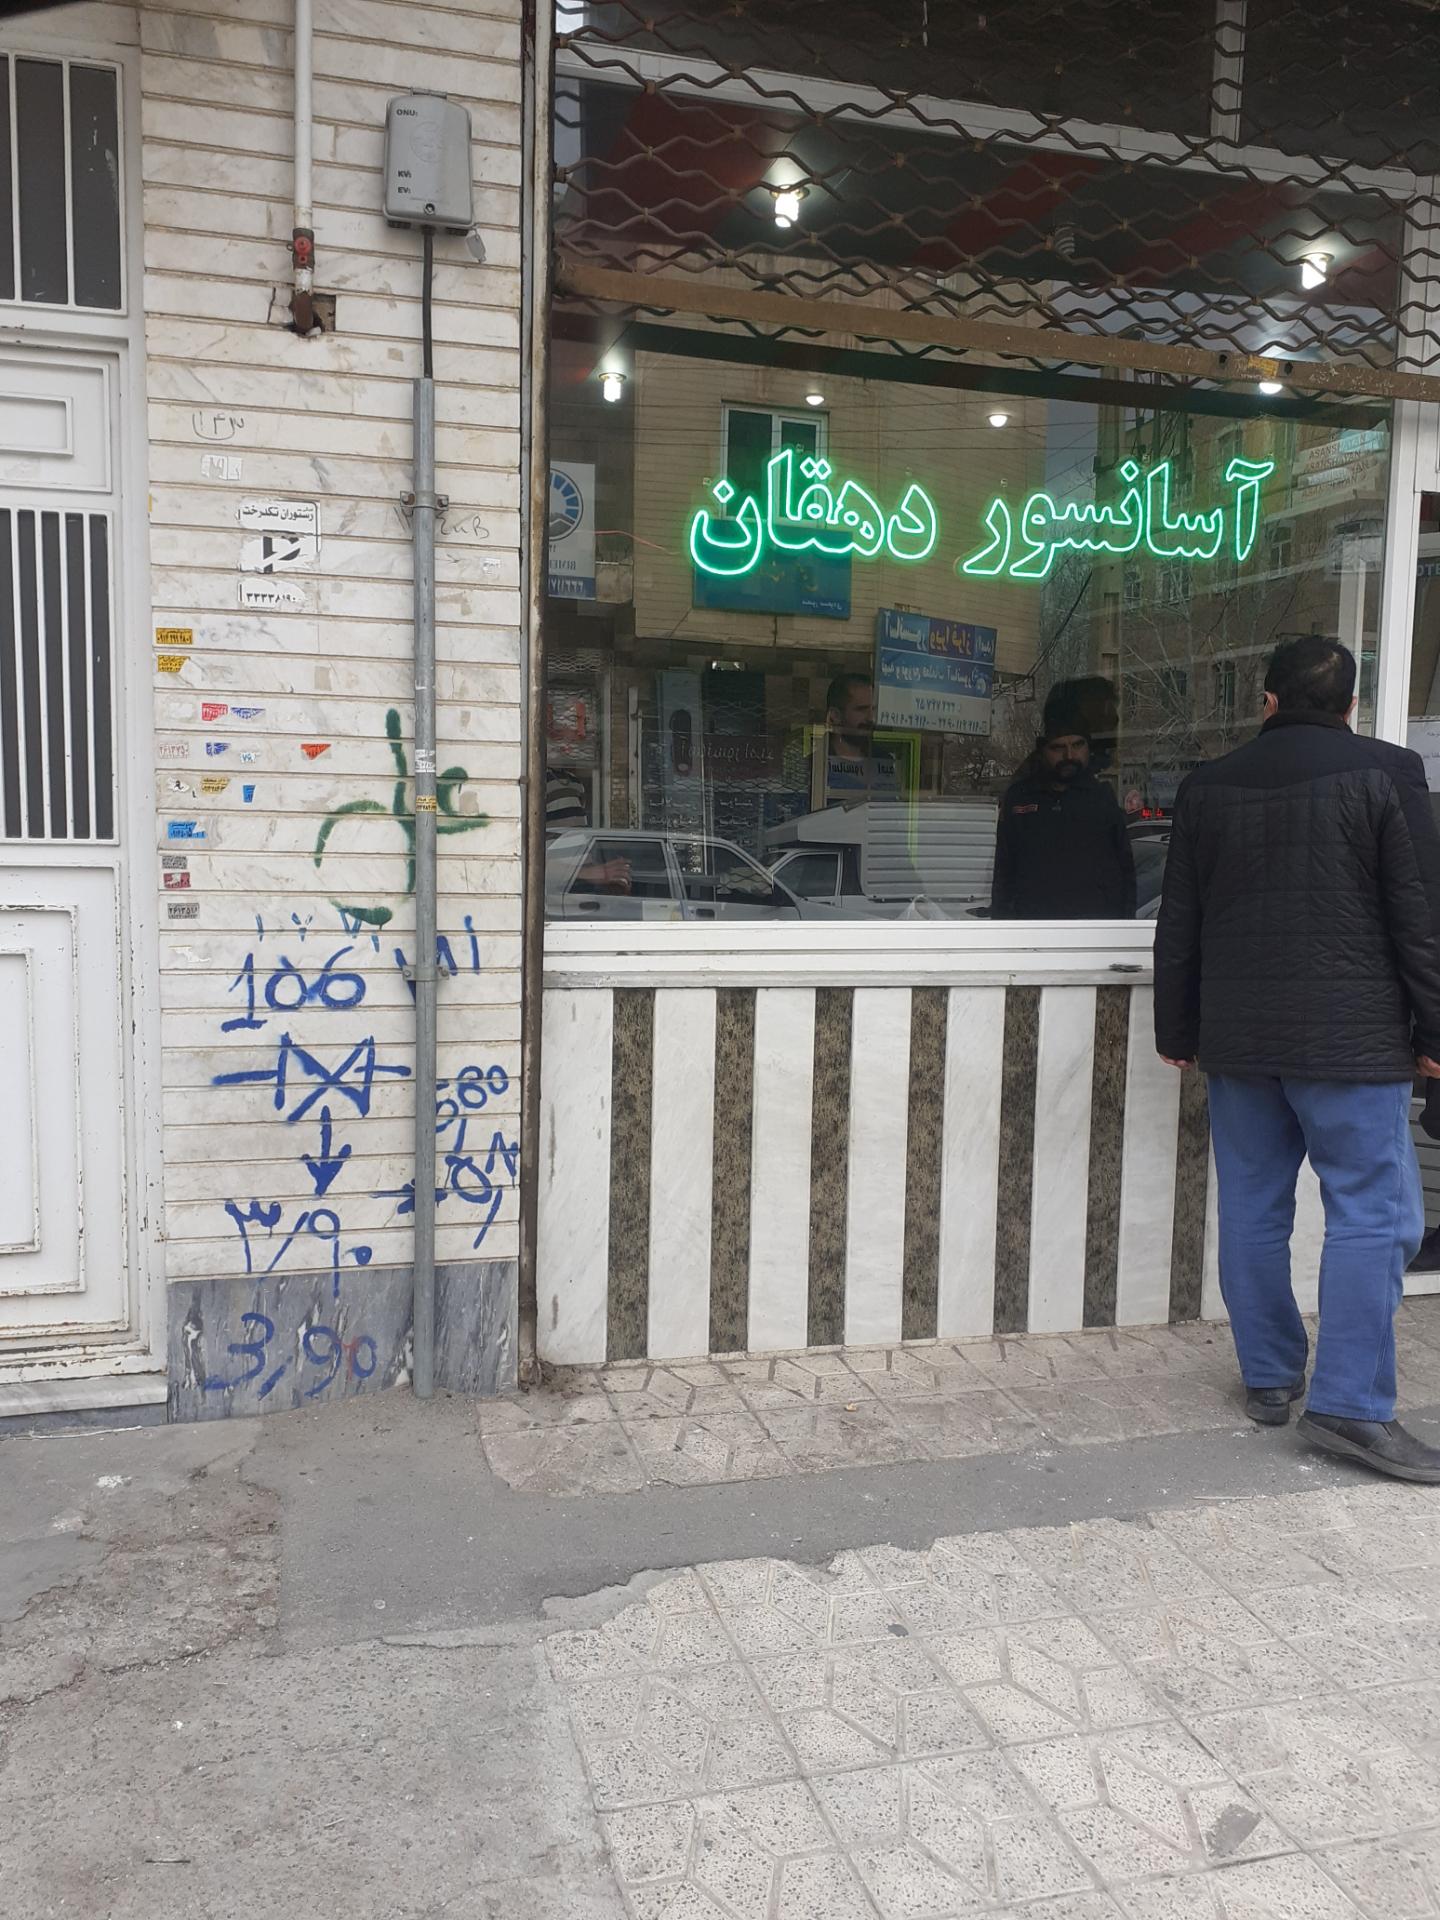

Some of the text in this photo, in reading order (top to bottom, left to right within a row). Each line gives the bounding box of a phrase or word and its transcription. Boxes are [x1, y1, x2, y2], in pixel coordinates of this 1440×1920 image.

[280, 507, 314, 521] رستوران
[689, 447, 1275, 578] آسانسور دهقان
